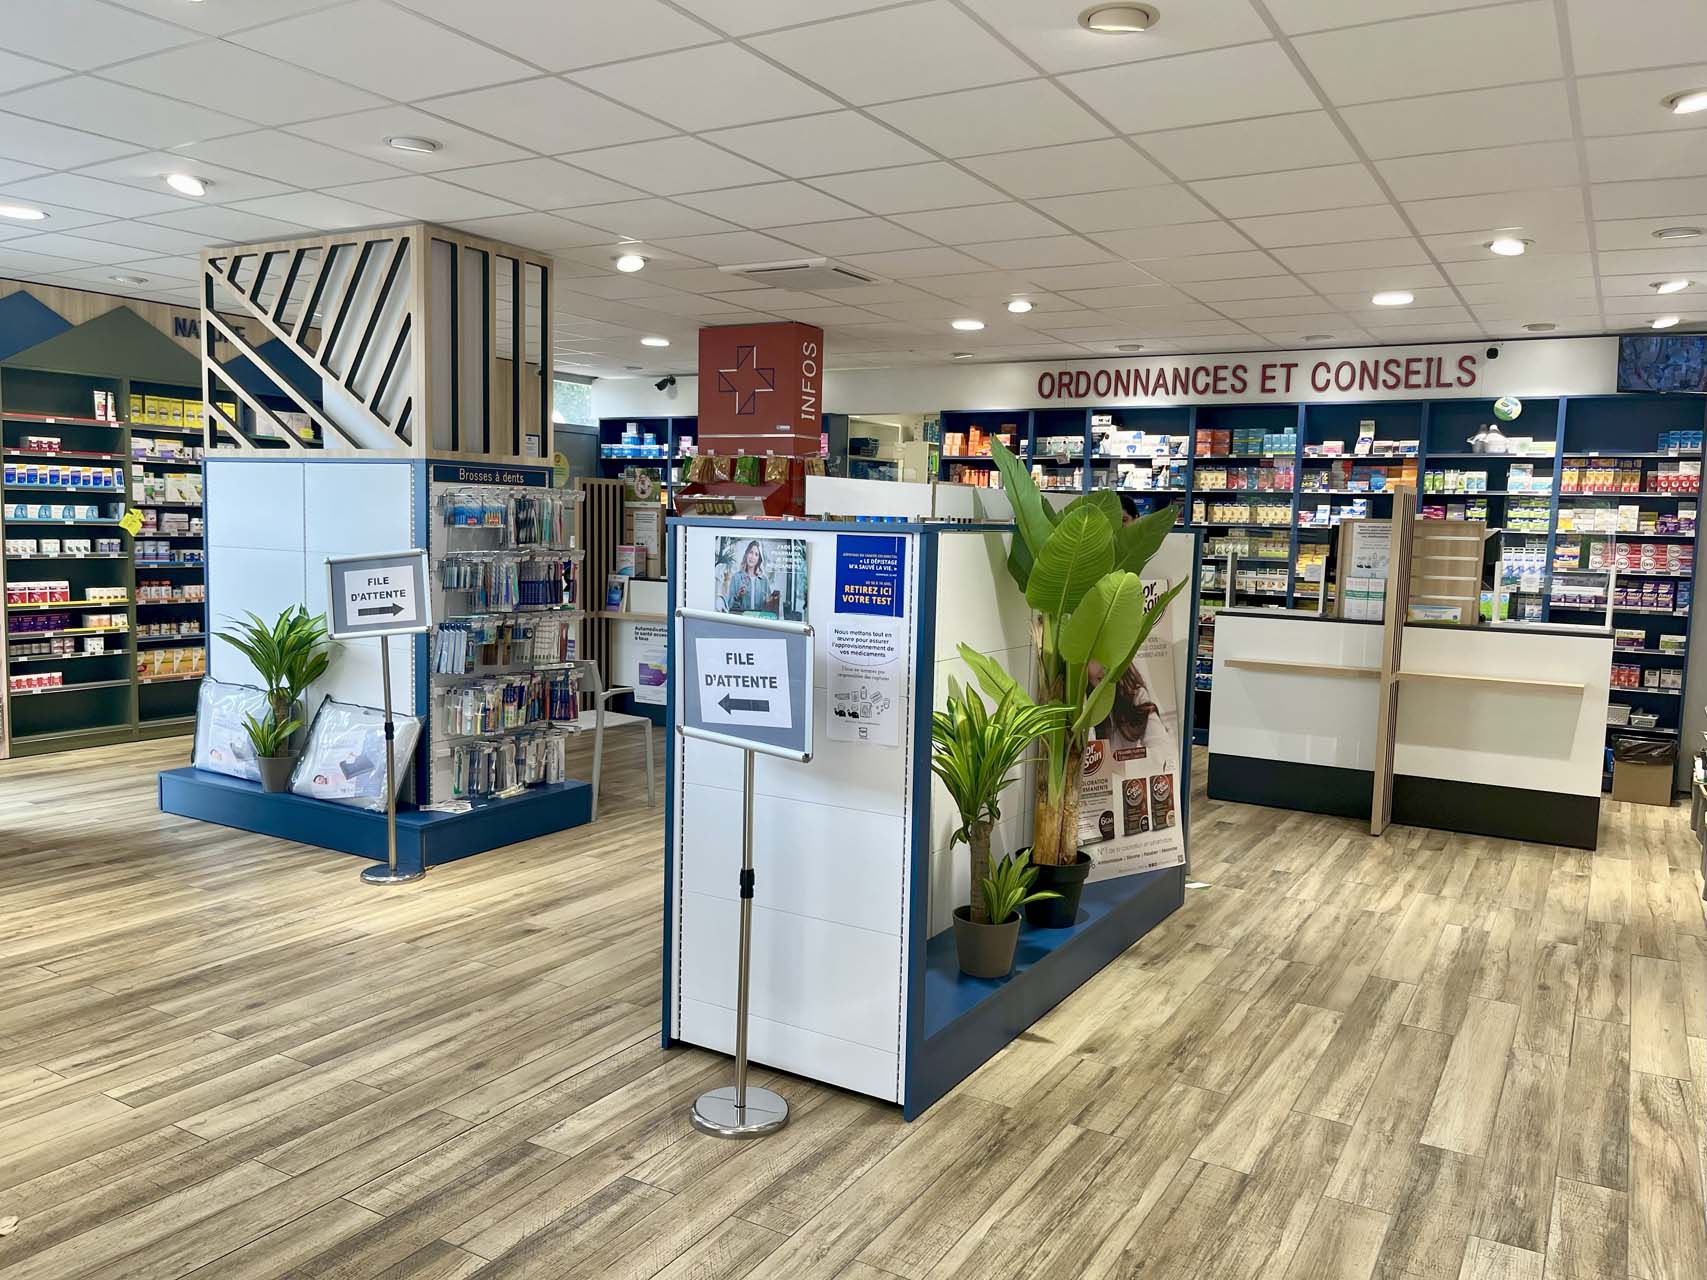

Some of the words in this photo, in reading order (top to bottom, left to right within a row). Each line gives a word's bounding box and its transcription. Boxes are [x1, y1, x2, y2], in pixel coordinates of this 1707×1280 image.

[801, 342, 817, 421] INFOS
[1037, 365, 1248, 399] ORDONNANCES
[1260, 363, 1299, 394] ET
[1311, 355, 1477, 392] CONSEILS
[459, 468, 493, 482] Brosses
[495, 472, 500, 481] à
[502, 472, 524, 484] dents
[367, 577, 390, 586] FILE
[351, 589, 406, 602] D'ATTENTE
[844, 585, 878, 595] RETIREZ
[880, 587, 892, 595] ICI
[842, 594, 870, 604] VOTRE
[872, 596, 892, 605] TEST
[832, 642, 886, 651] l'approvisionnement
[726, 652, 755, 666] FILE
[705, 673, 778, 689] D'ATTENTE
